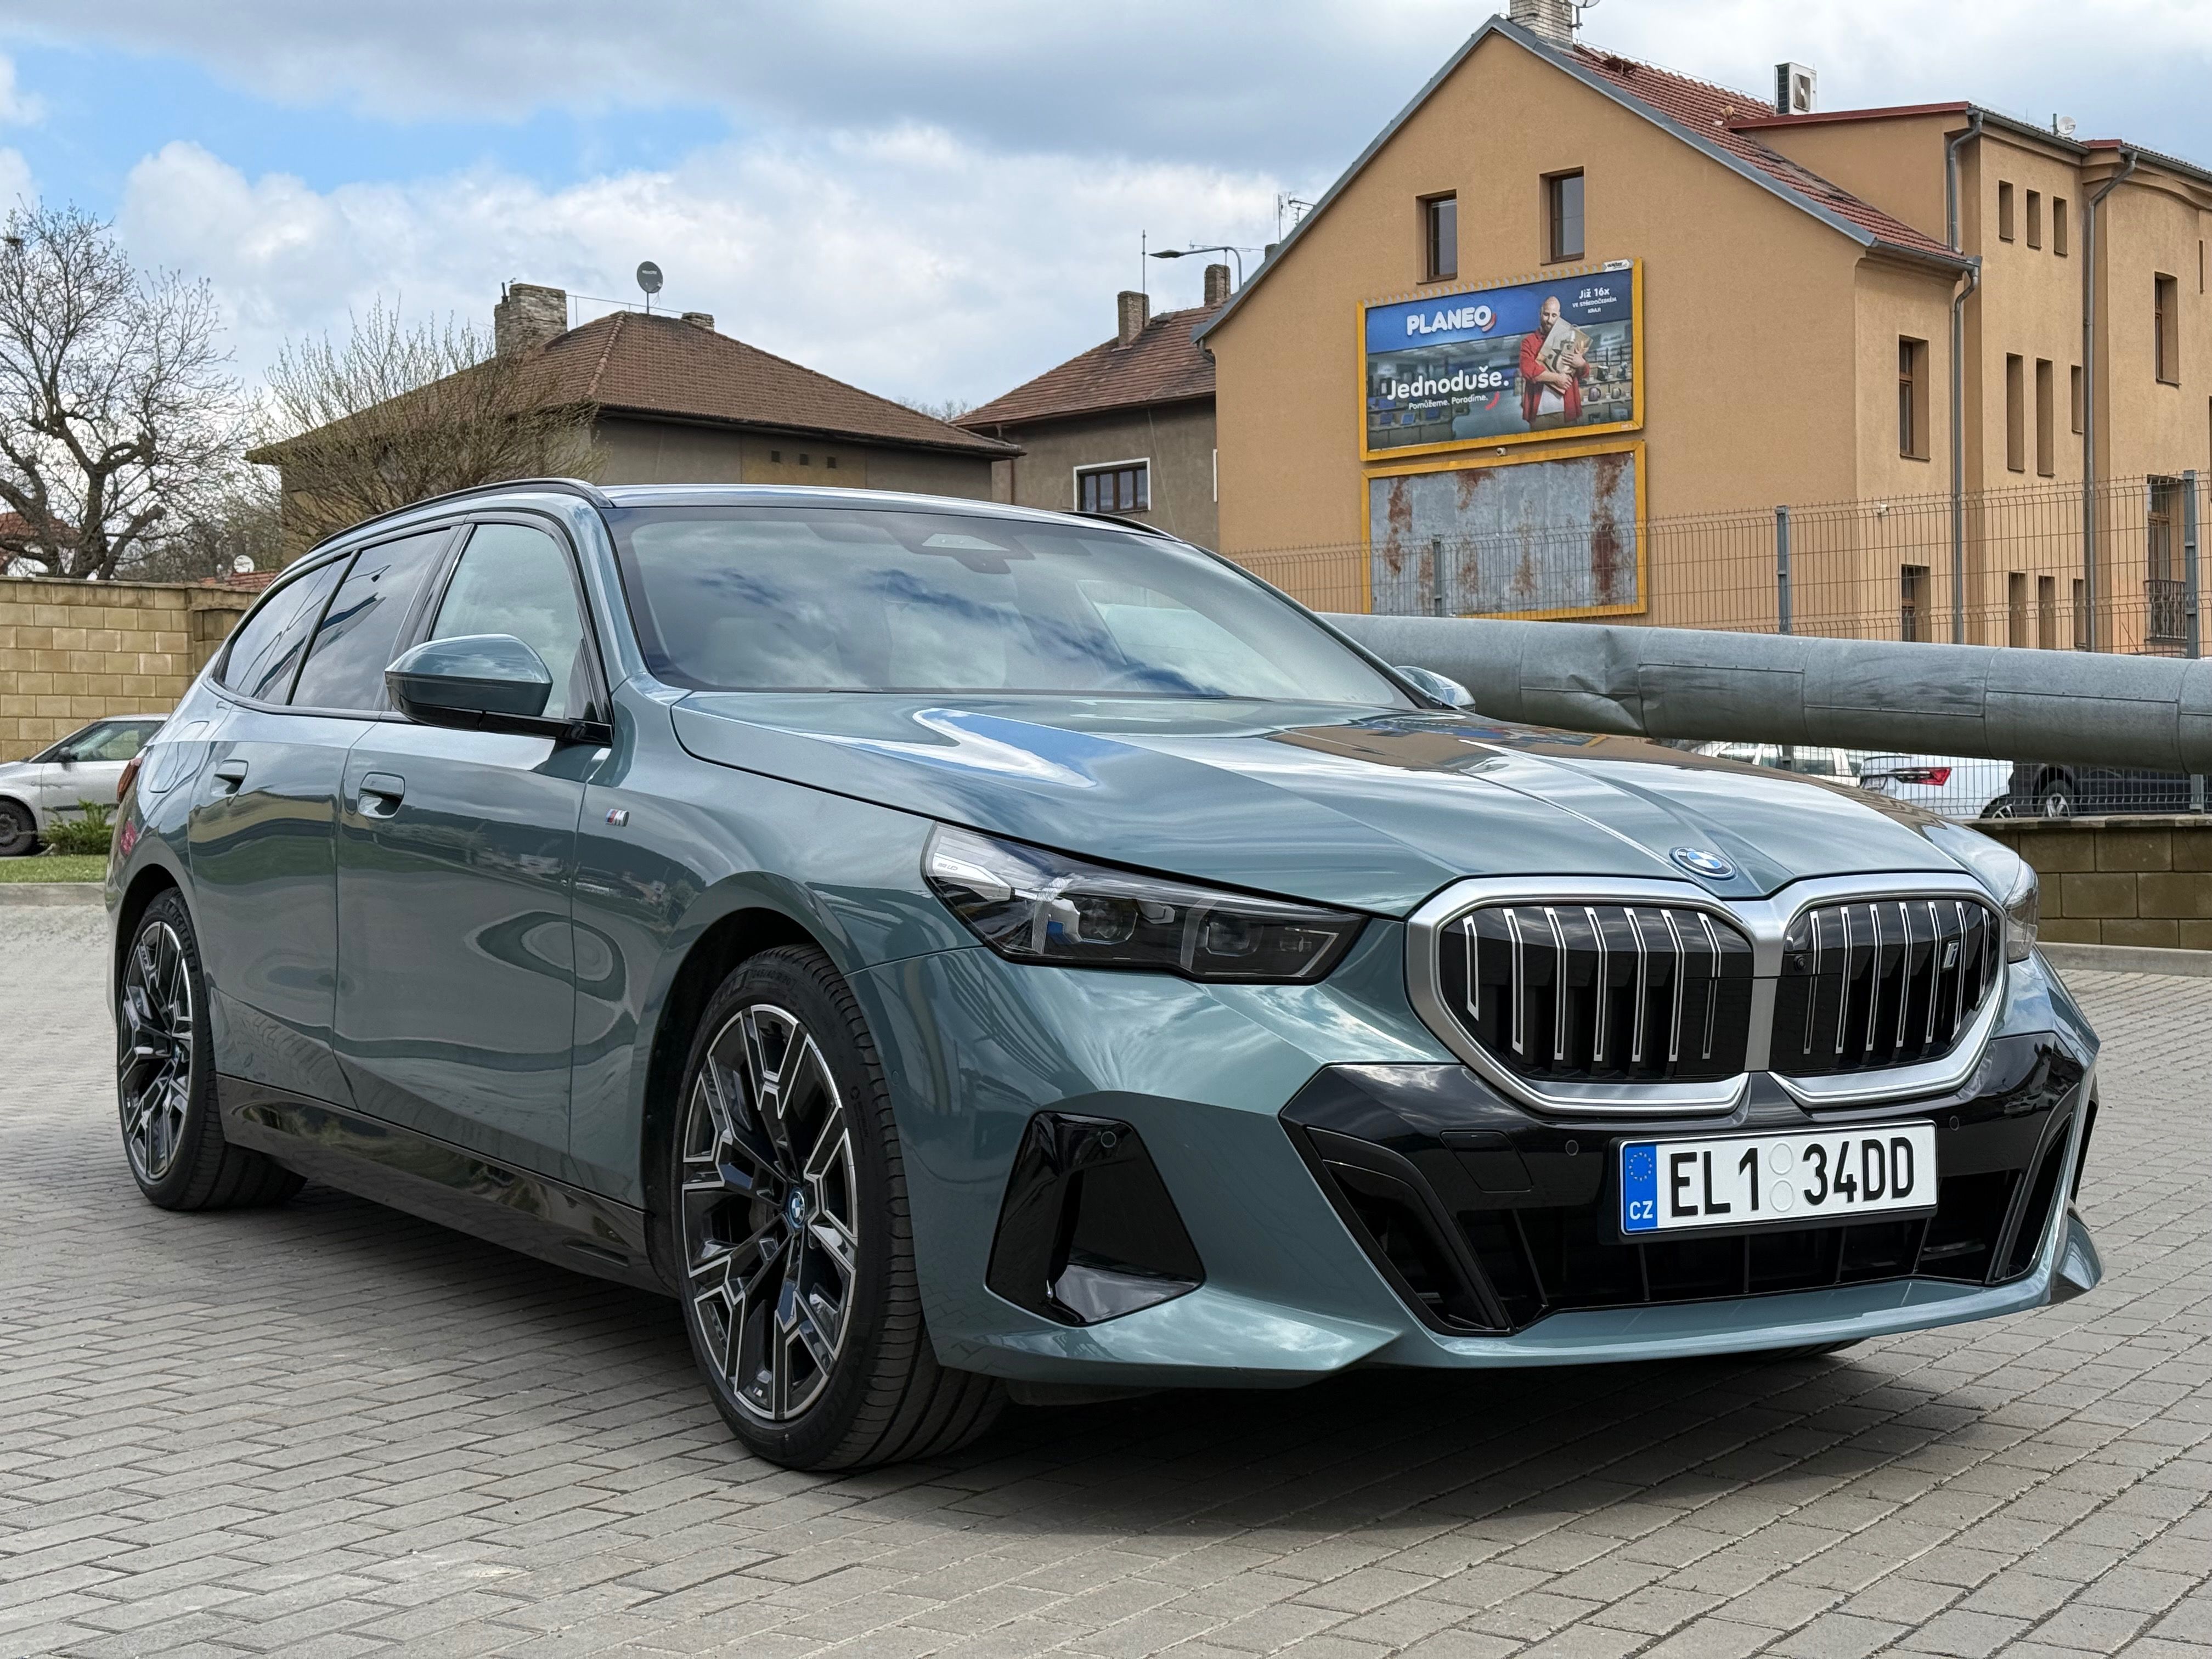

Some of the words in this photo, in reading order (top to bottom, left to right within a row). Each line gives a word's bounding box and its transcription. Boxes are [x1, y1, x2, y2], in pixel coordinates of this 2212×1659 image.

[1579, 288, 1592, 299] Již
[1594, 287, 1610, 297] 16x
[1407, 305, 1492, 336] PLANEO
[1387, 365, 1509, 400] Jednoduše.
[1629, 1200, 1654, 1221] CZ
